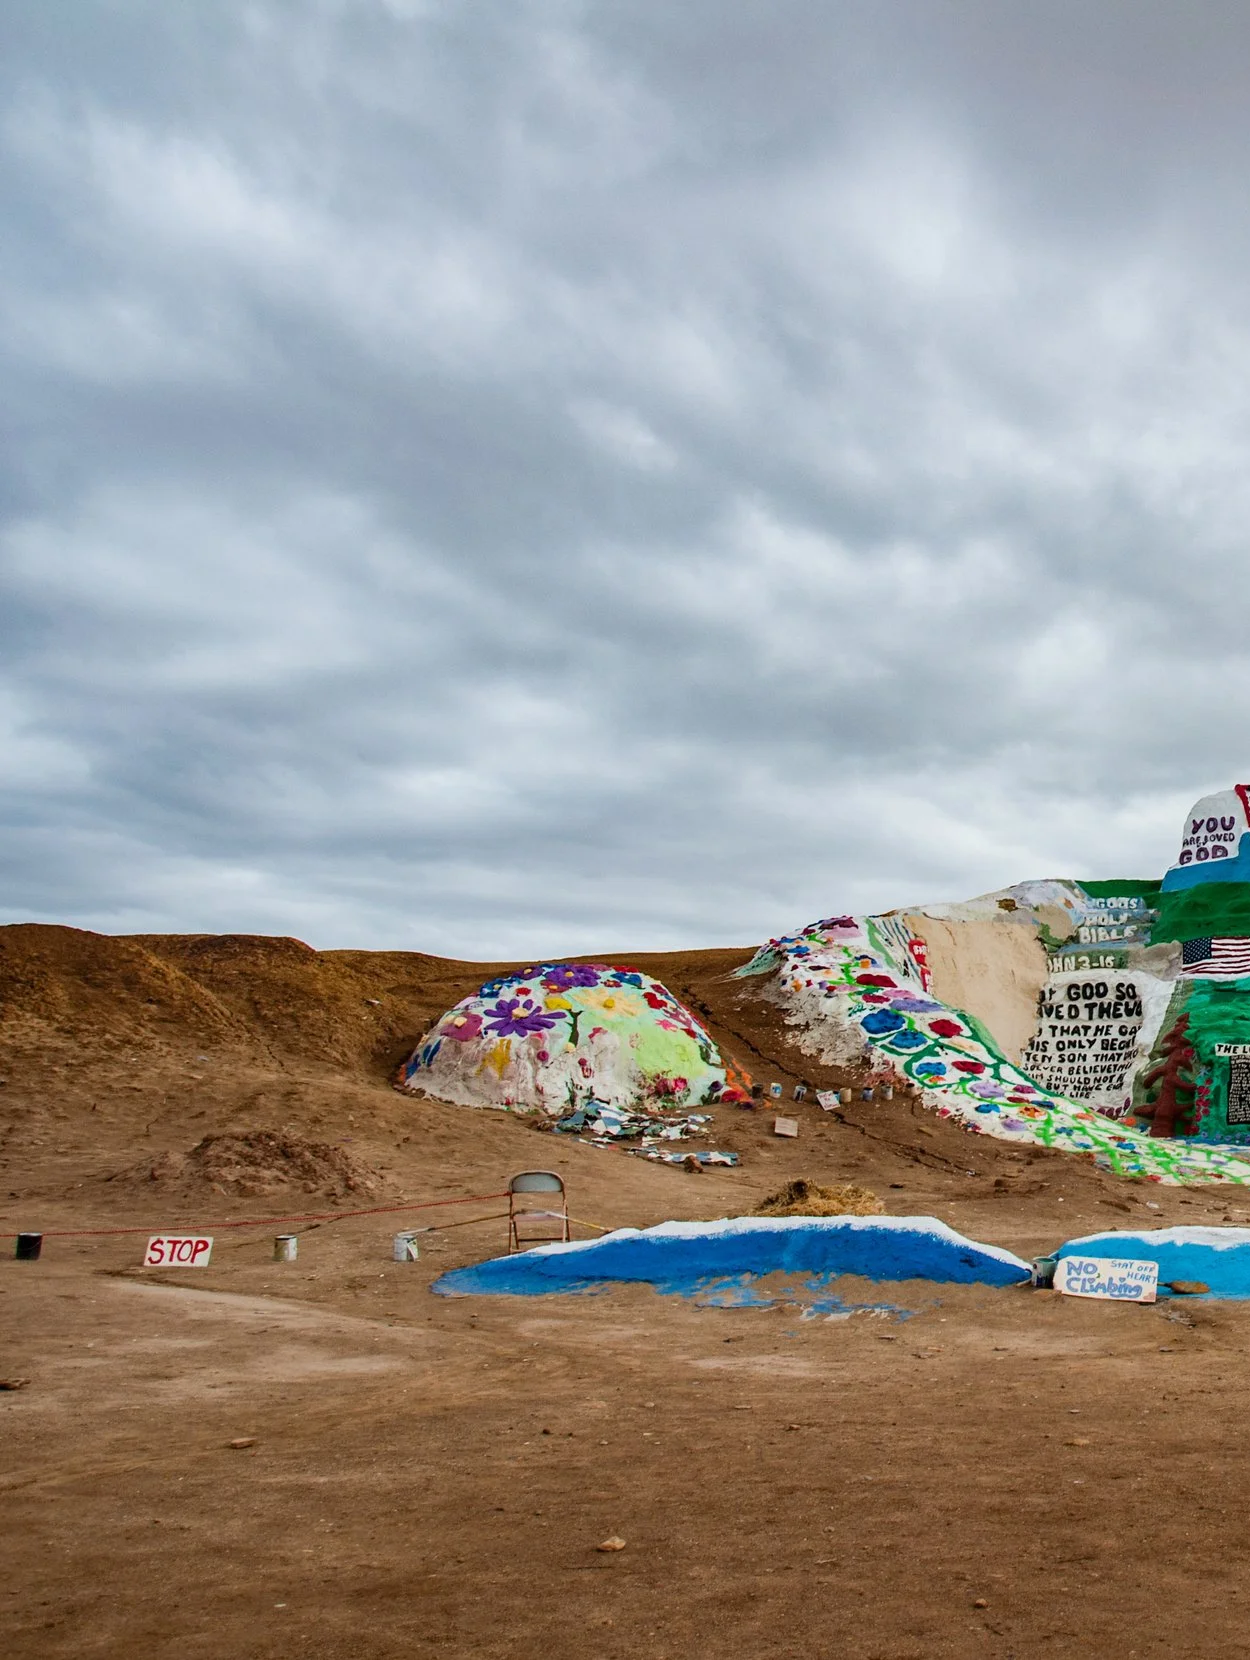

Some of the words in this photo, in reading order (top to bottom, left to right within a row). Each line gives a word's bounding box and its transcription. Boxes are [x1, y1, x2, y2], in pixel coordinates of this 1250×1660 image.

[1191, 816, 1235, 835] YOU
[1183, 836, 1201, 848] ARE
[1202, 832, 1235, 846] LOVED
[1179, 845, 1228, 865] GOD
[1079, 926, 1137, 944] BIBLE
[1047, 956, 1075, 973] HN
[1078, 956, 1115, 970] 3-16
[1067, 982, 1108, 1001] GOD
[1115, 982, 1137, 1001] SO
[1084, 1001, 1123, 1020] THE
[1048, 1024, 1091, 1037] THAT
[1093, 1024, 1113, 1037] HE
[1056, 1038, 1097, 1052] ONLY
[1217, 1044, 1239, 1054] THE
[1025, 1052, 1052, 1063] TEN
[1058, 1053, 1087, 1063] SON
[1092, 1052, 1123, 1062] THAT
[1046, 1082, 1069, 1091] BUT
[1073, 1083, 1102, 1092] HAVE
[1047, 1075, 1091, 1085] SHOULD
[1093, 1074, 1116, 1085] NOT
[148, 1238, 209, 1264] STOP
[1066, 1261, 1098, 1276] NO
[1137, 1265, 1156, 1273] OFF
[1127, 1271, 1157, 1284] HEART
